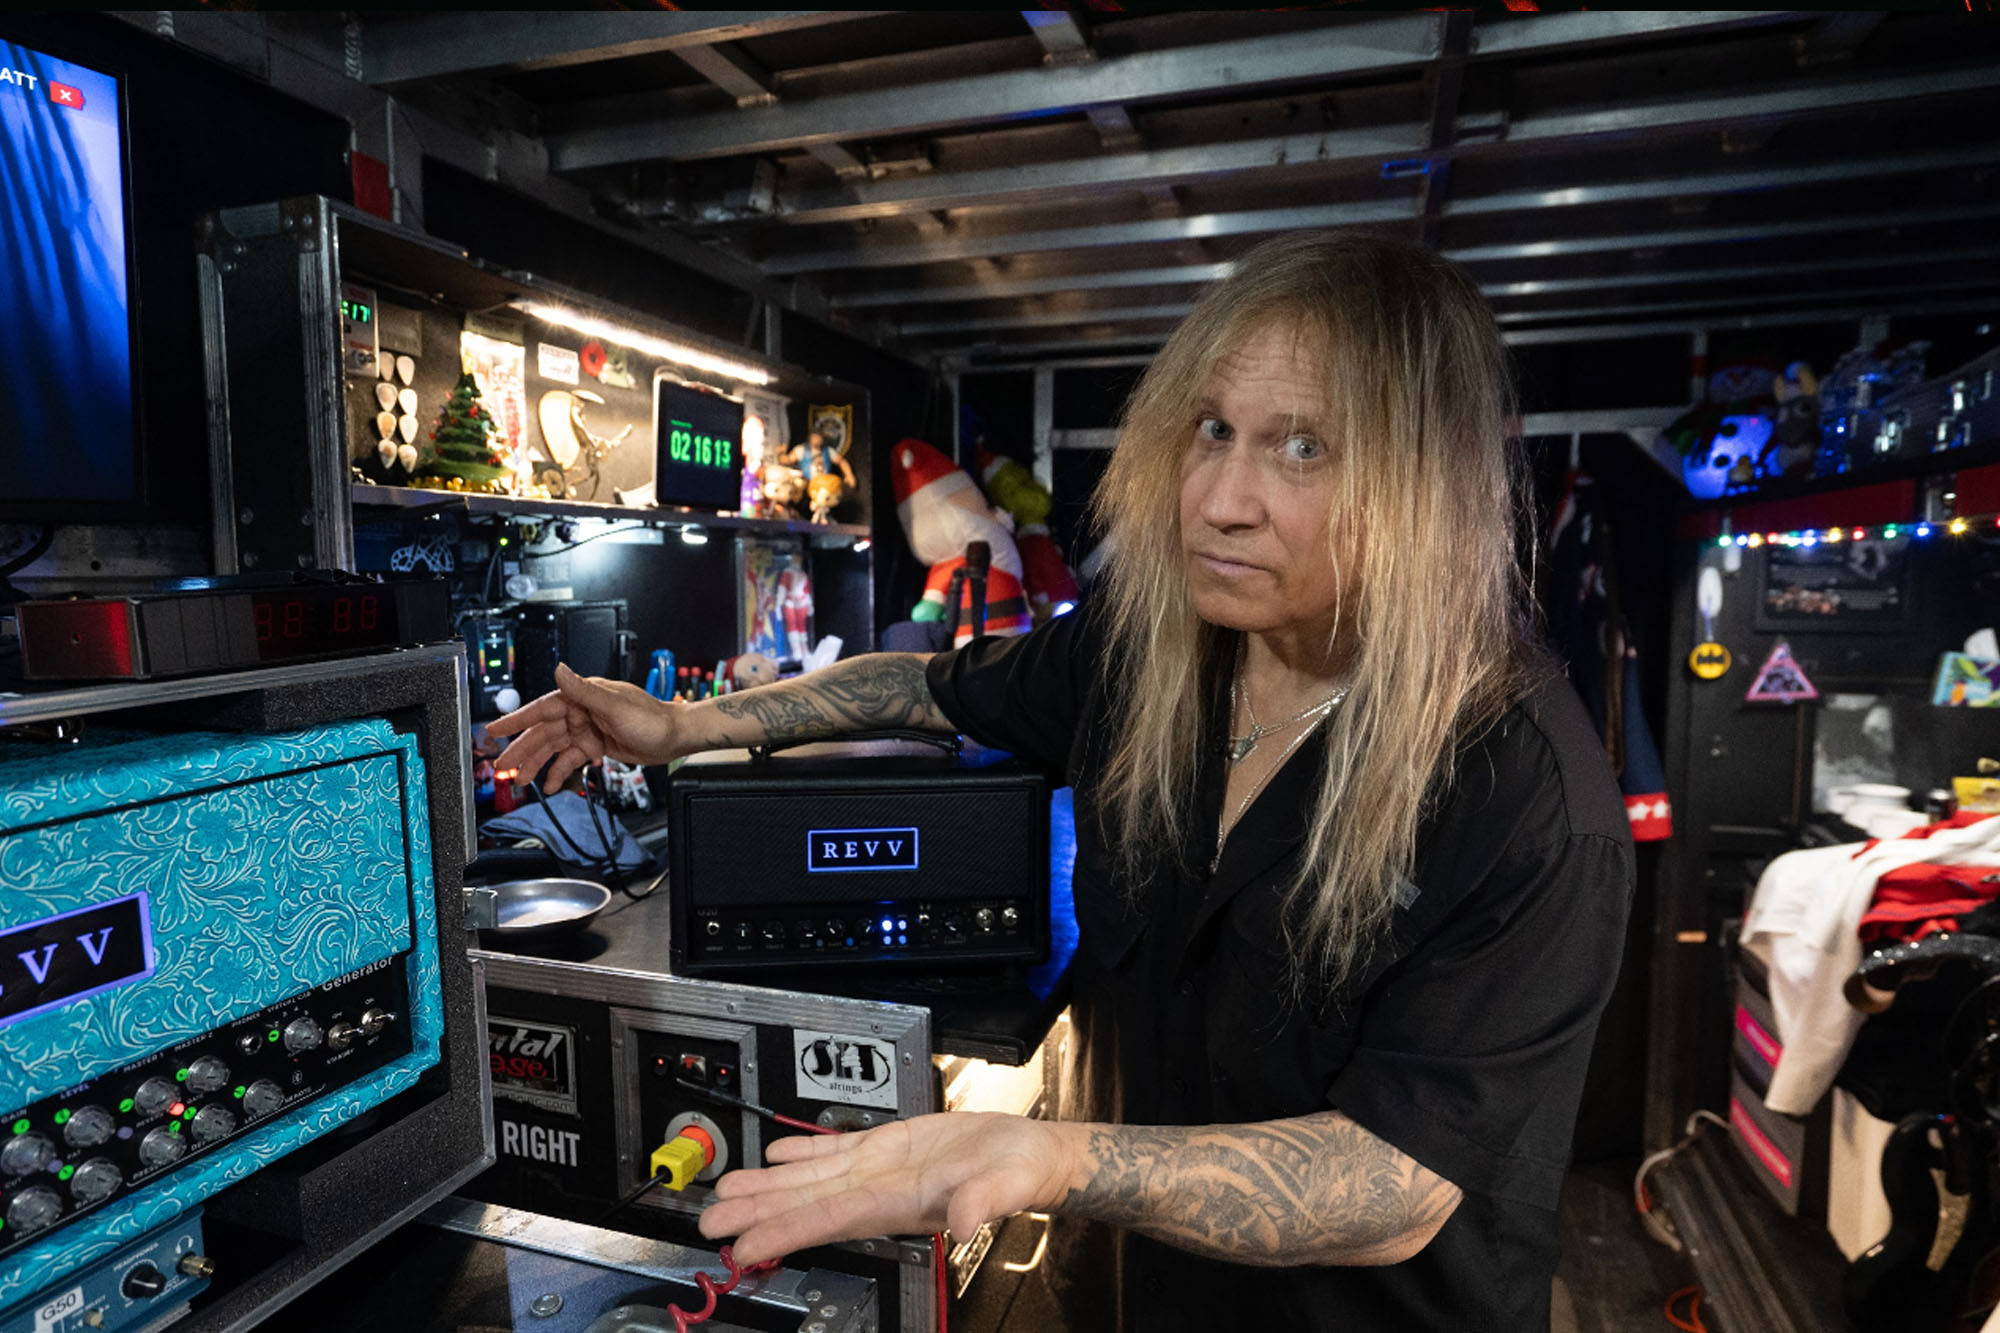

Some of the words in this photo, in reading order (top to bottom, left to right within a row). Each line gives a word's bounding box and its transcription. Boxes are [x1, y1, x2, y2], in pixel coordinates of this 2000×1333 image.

[822, 839, 905, 859] REVV
[0, 926, 114, 997] VV
[321, 957, 394, 992] Generator
[829, 1082, 863, 1095] strings
[501, 1119, 581, 1168] RIGHT
[41, 1292, 76, 1322] G50
